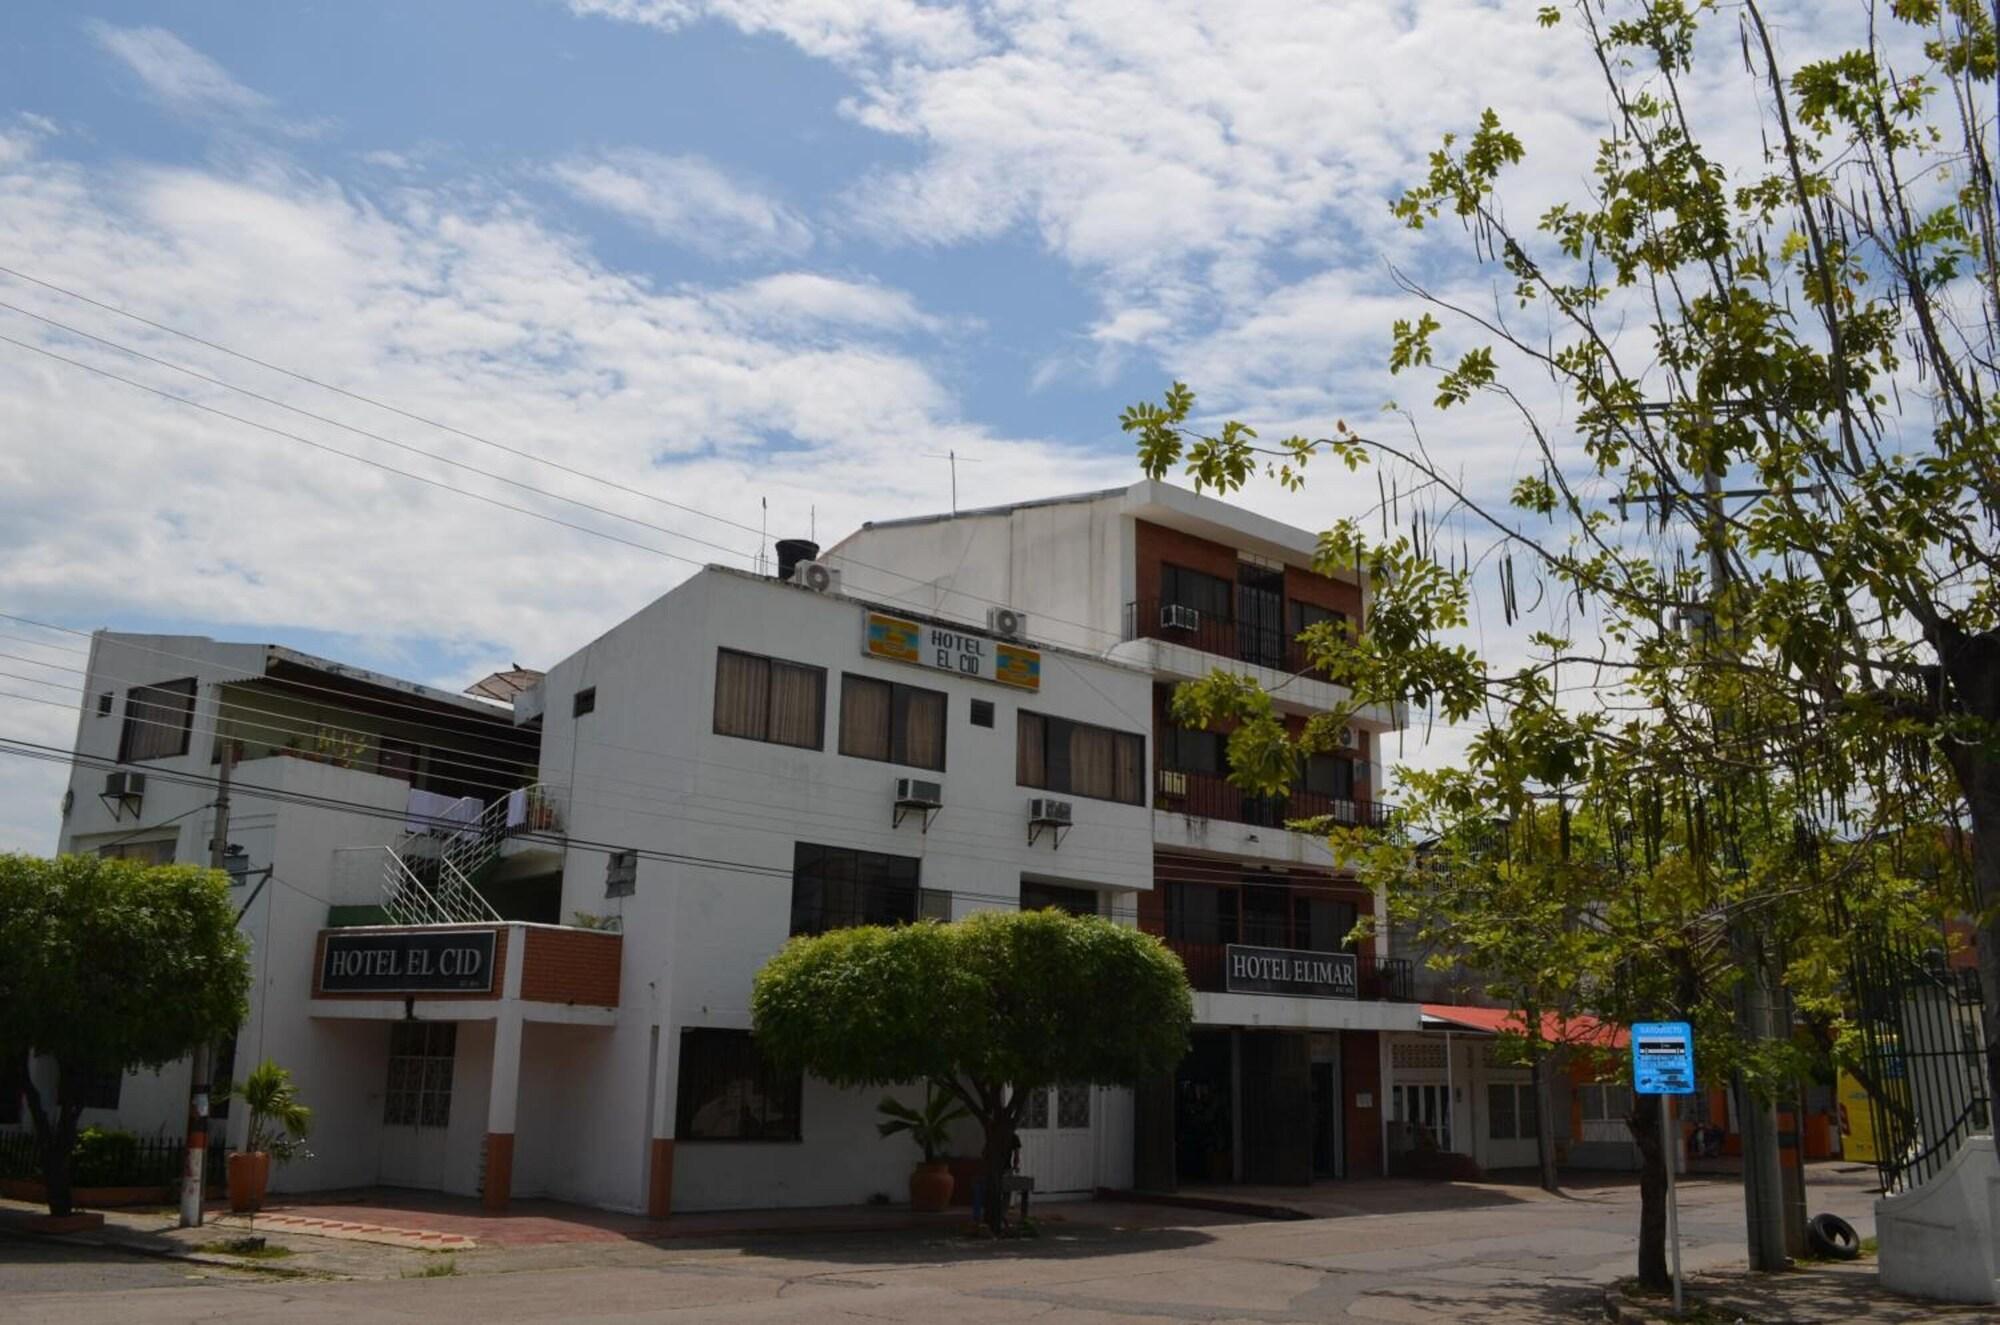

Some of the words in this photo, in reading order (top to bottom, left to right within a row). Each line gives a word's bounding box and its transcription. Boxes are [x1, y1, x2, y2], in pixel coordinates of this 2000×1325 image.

[931, 630, 986, 657] HOTEL
[937, 649, 953, 669] EL
[959, 654, 979, 675] CID
[332, 949, 401, 976] HOTEL
[406, 949, 434, 976] EL
[439, 948, 481, 976] CID
[1232, 955, 1291, 980] HOTEL
[1294, 961, 1354, 985] ELIMAR
